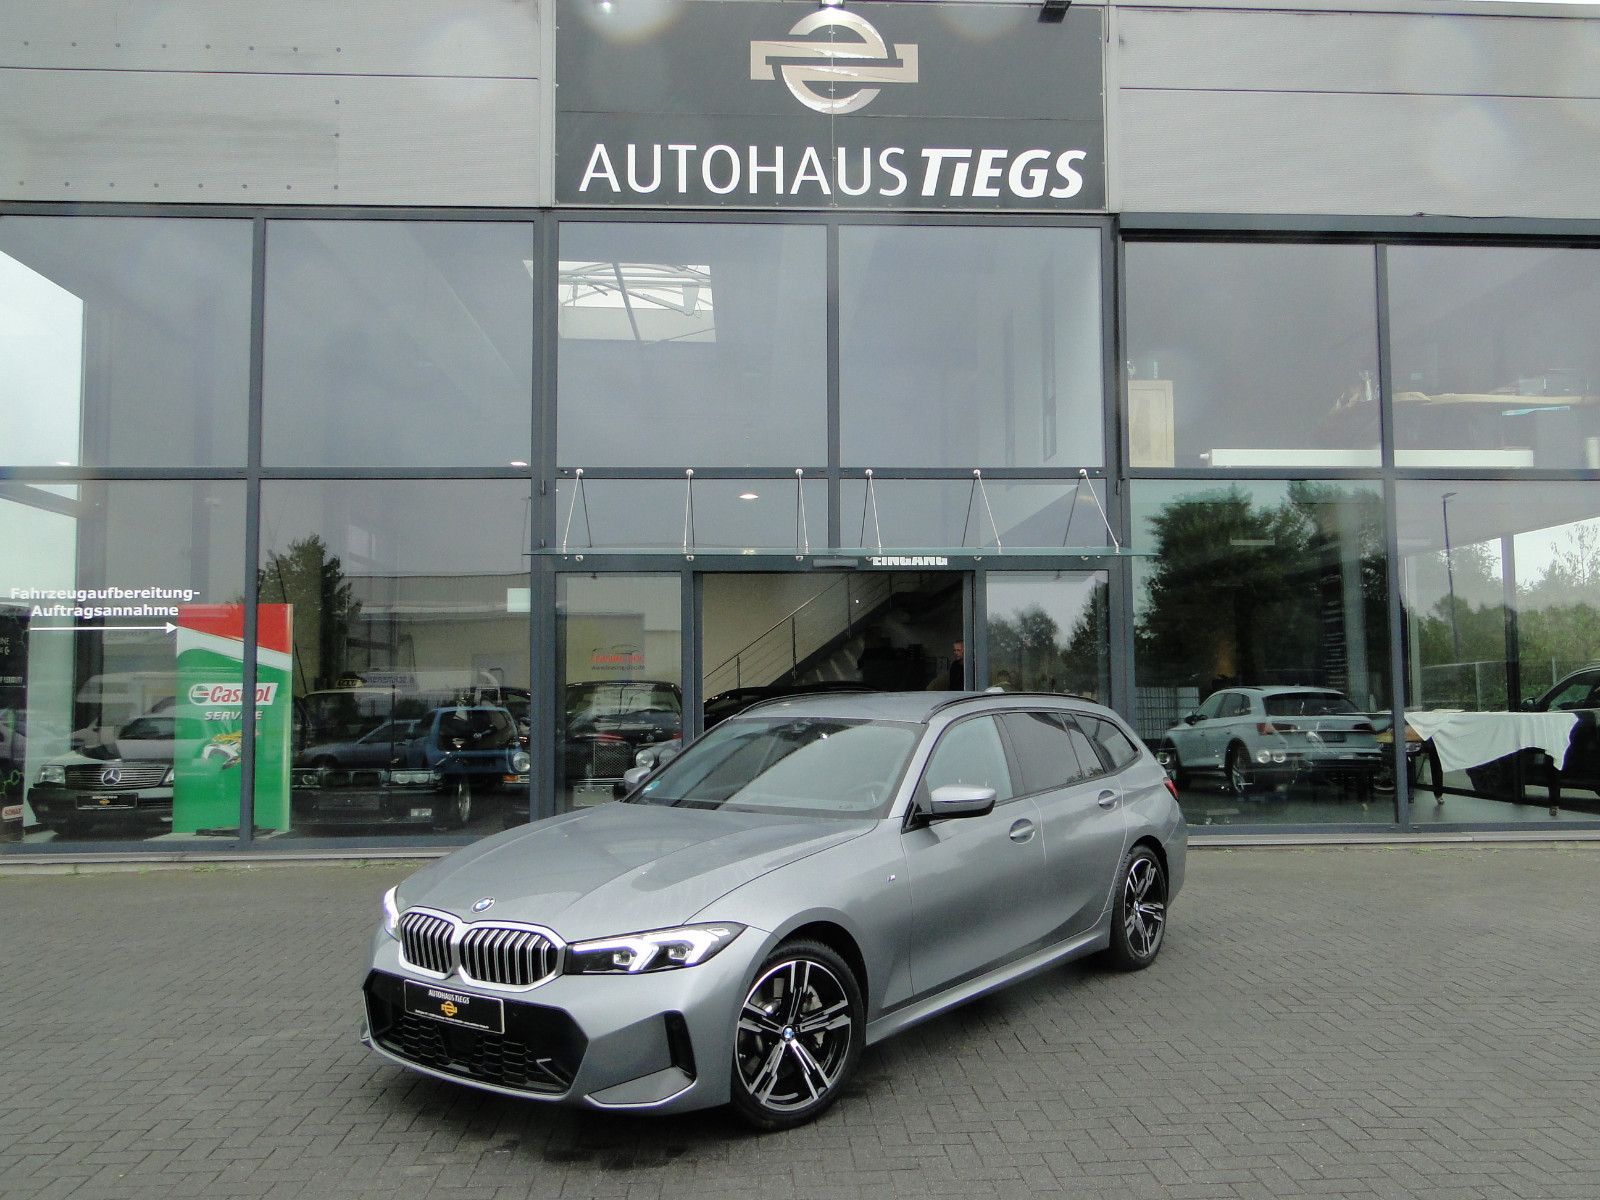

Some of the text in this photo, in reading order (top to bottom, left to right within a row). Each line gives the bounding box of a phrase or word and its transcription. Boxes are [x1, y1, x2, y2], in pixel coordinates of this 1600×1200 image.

[578, 143, 908, 197] AUTOHAUS
[10, 587, 201, 602] Fahrzeugaufbereitung-
[31, 604, 179, 619] Auftragsannahme
[210, 685, 272, 703] Casol
[204, 710, 263, 720] SERVE
[428, 989, 455, 1002] AUTOHAUS
